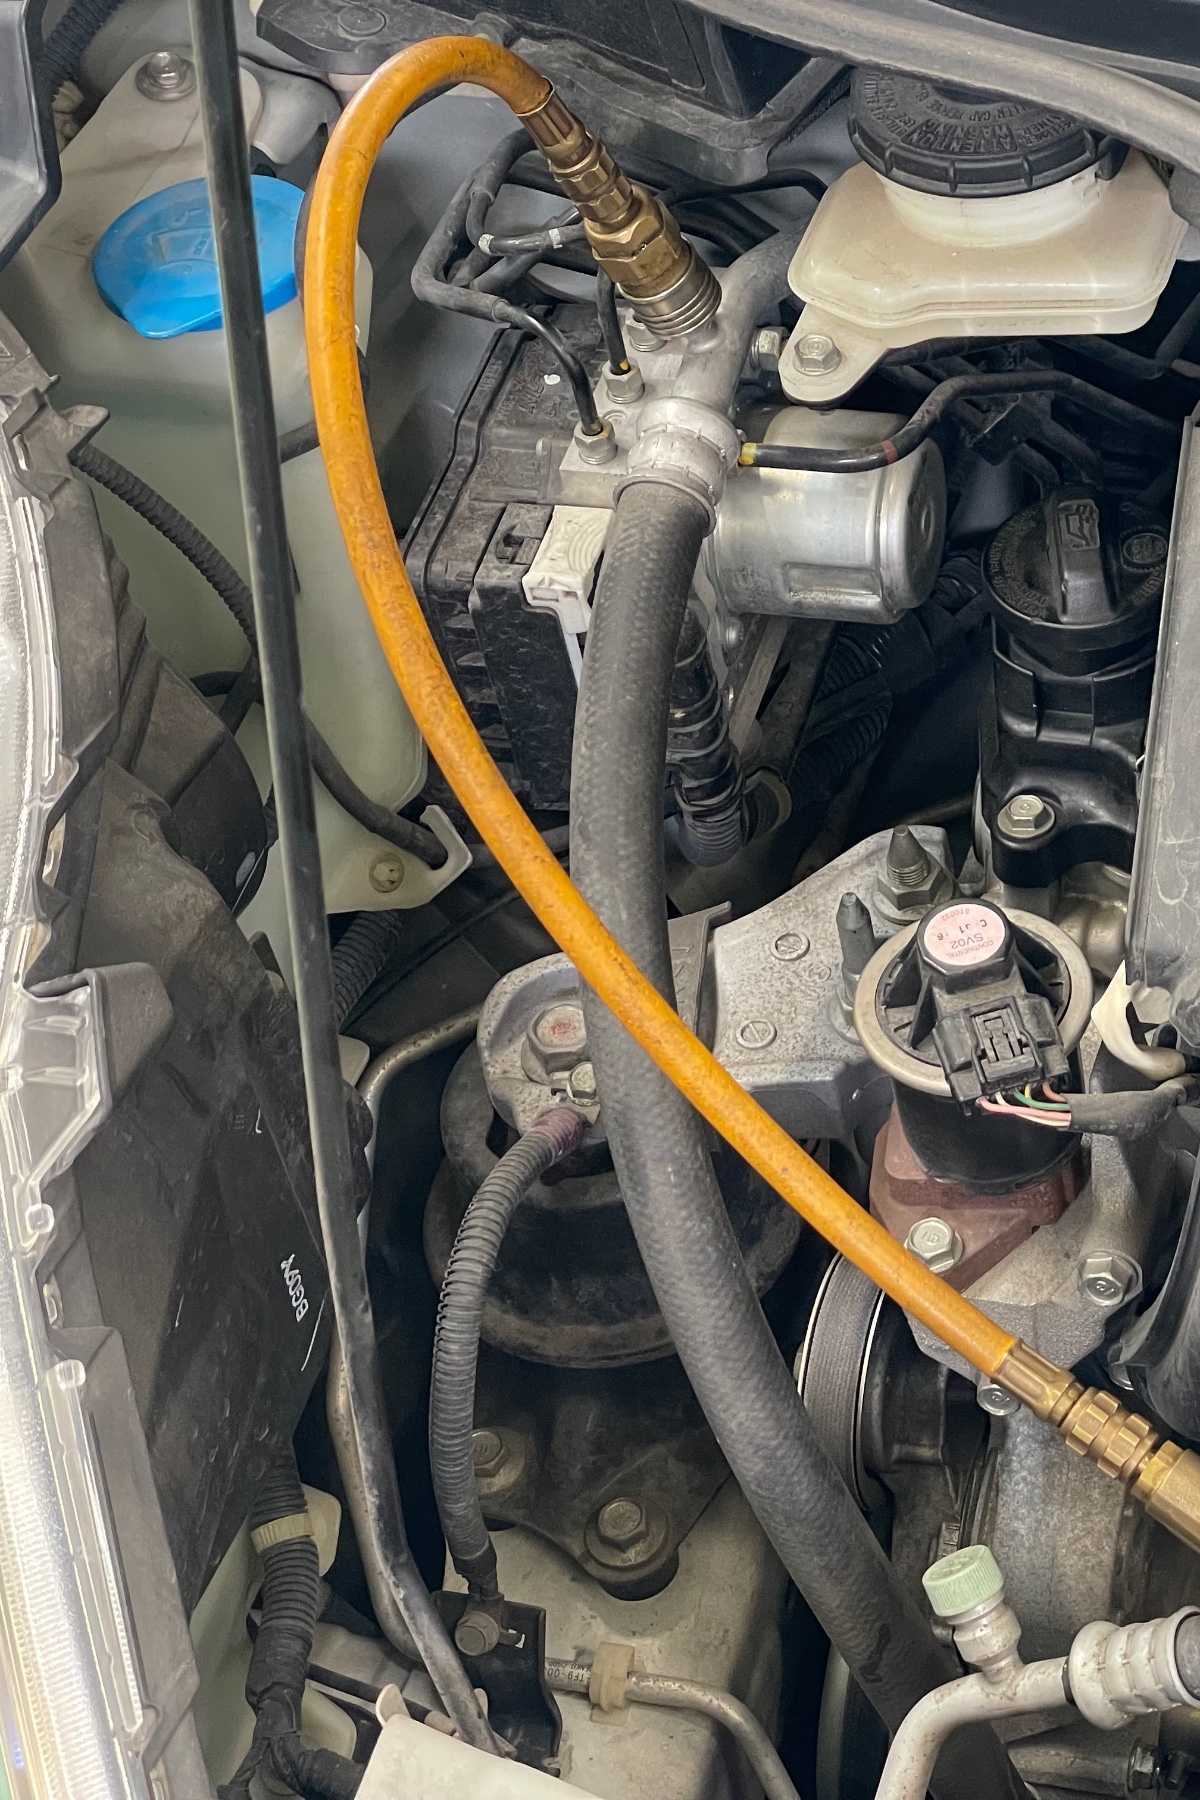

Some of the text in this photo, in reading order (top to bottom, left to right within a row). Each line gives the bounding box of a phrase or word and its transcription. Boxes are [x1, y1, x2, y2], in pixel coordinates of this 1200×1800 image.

[912, 126, 1012, 153] ATTENTION
[945, 940, 994, 958] CONTINENTAL
[949, 932, 984, 950] SV02
